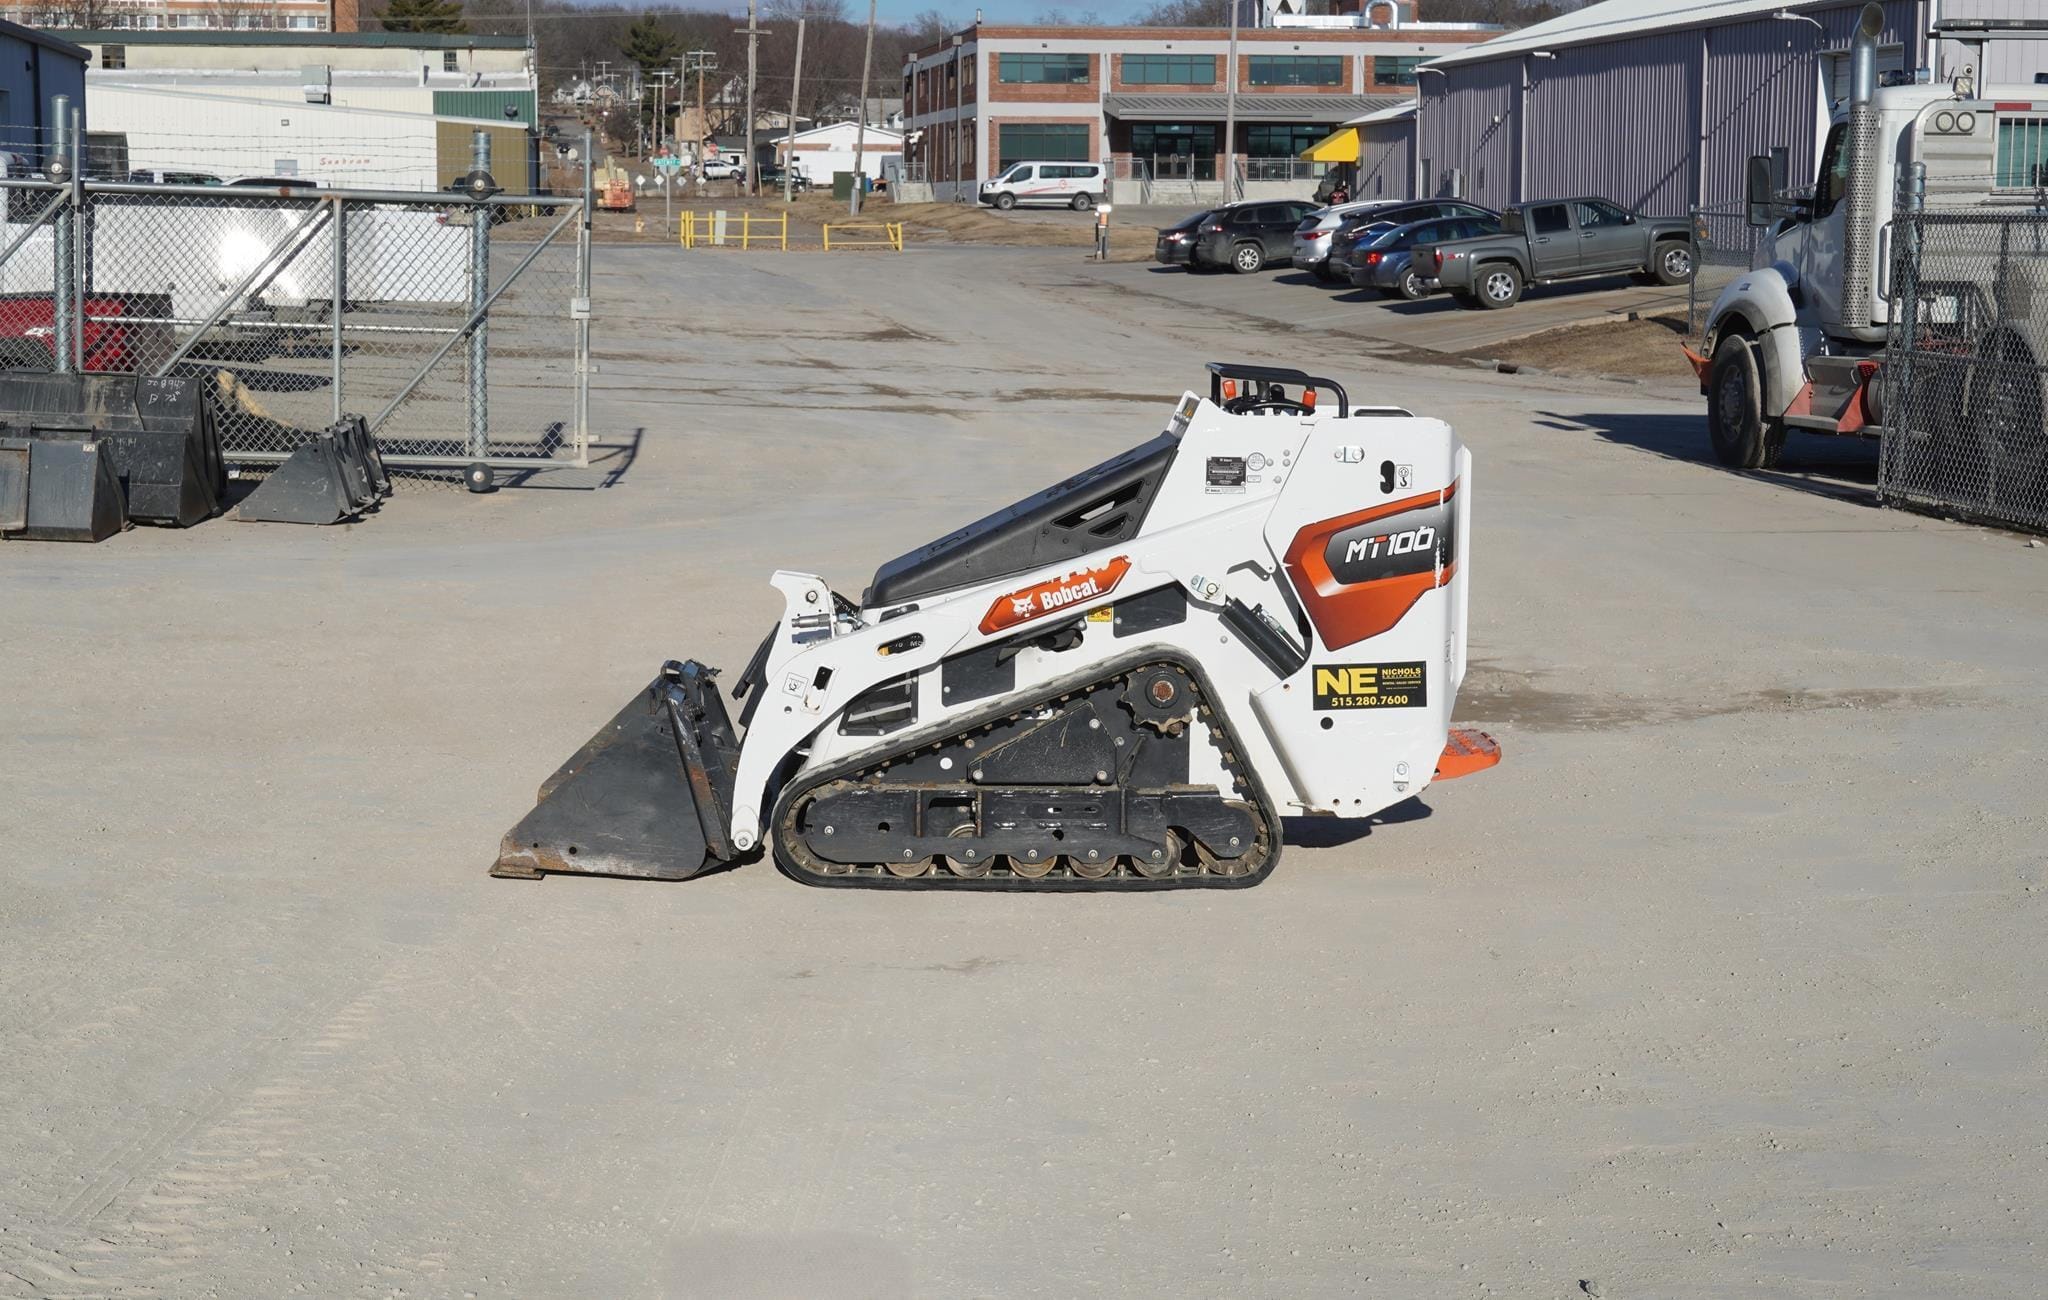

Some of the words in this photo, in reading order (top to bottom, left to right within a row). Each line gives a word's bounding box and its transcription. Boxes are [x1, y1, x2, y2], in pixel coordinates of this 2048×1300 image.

[1345, 526, 1435, 563] MT100
[1040, 577, 1099, 610] Bobcat
[1317, 668, 1378, 695] NE
[1382, 667, 1421, 675] NICHOLS
[1331, 695, 1408, 706] 515.280.7600
